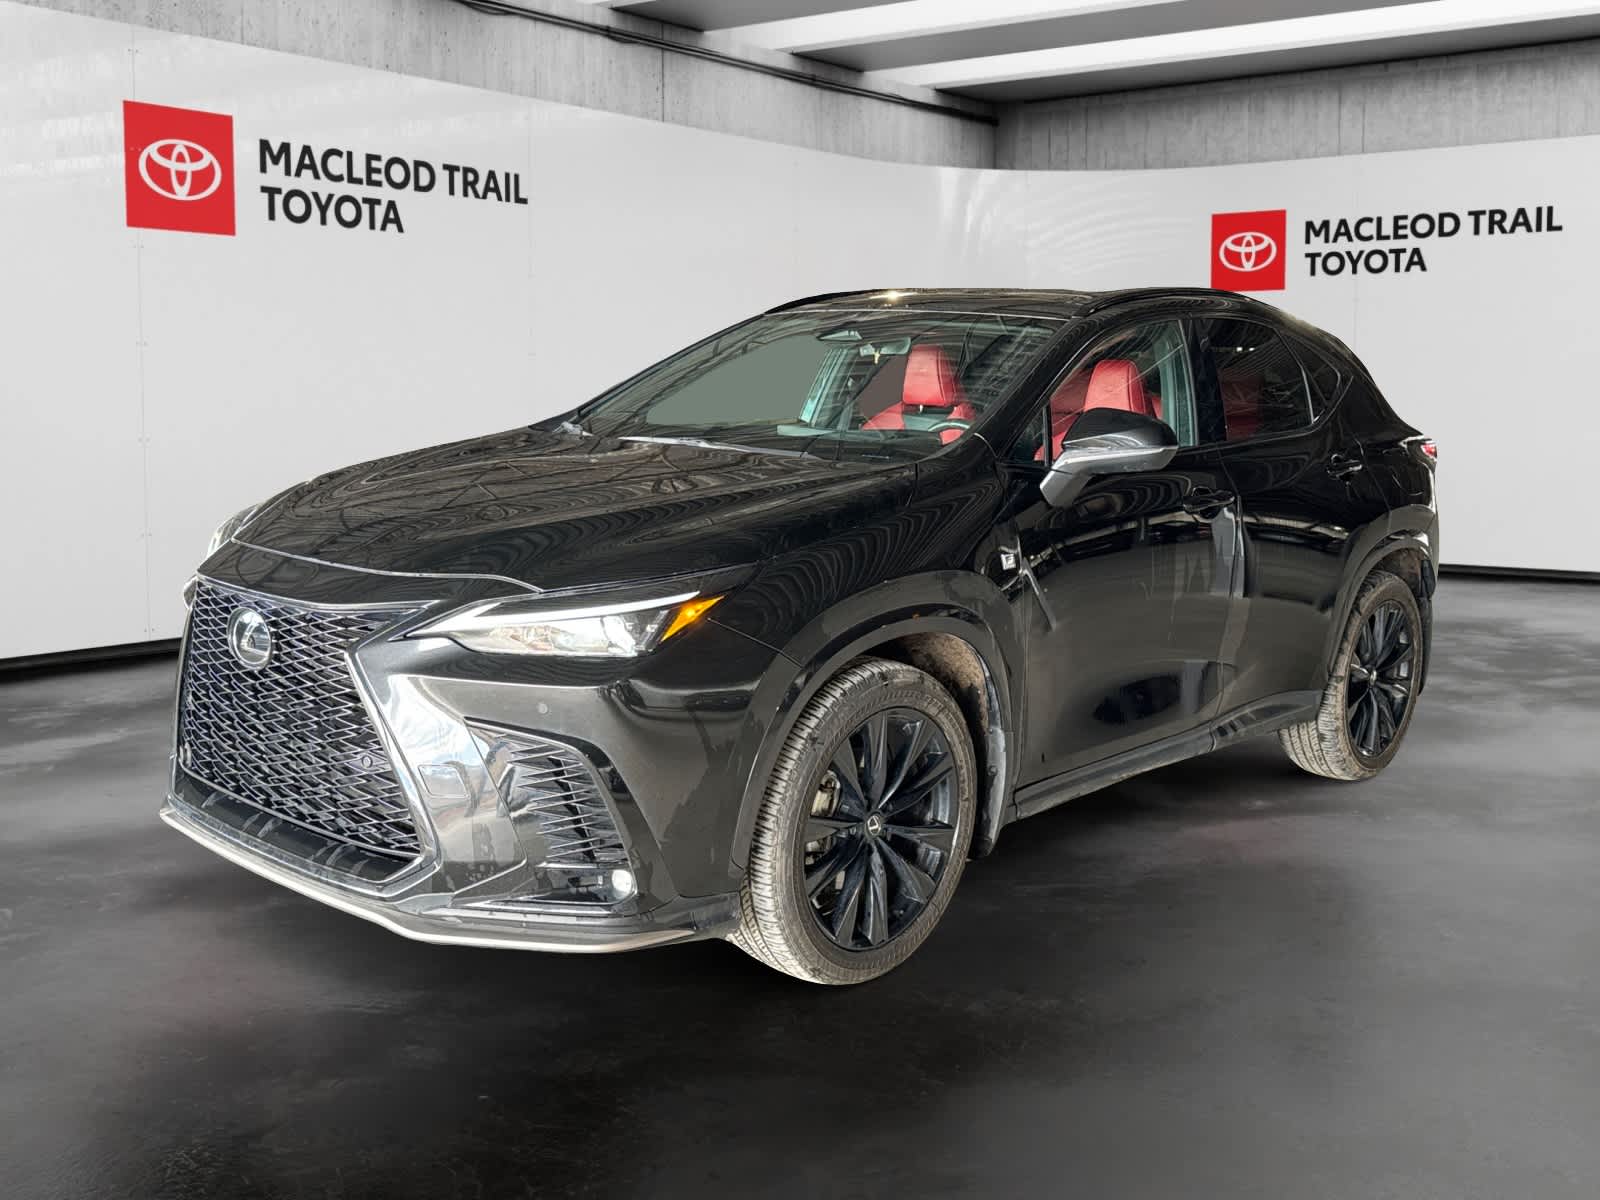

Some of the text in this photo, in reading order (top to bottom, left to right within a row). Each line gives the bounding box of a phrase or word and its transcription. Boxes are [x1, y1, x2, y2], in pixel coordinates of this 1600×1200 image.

[259, 138, 529, 205] MACLEOD TRAIL
[260, 185, 404, 233] TOYOTA
[1304, 205, 1563, 245] MACLEOD TRAIL
[1304, 247, 1427, 277] TOYOTA
